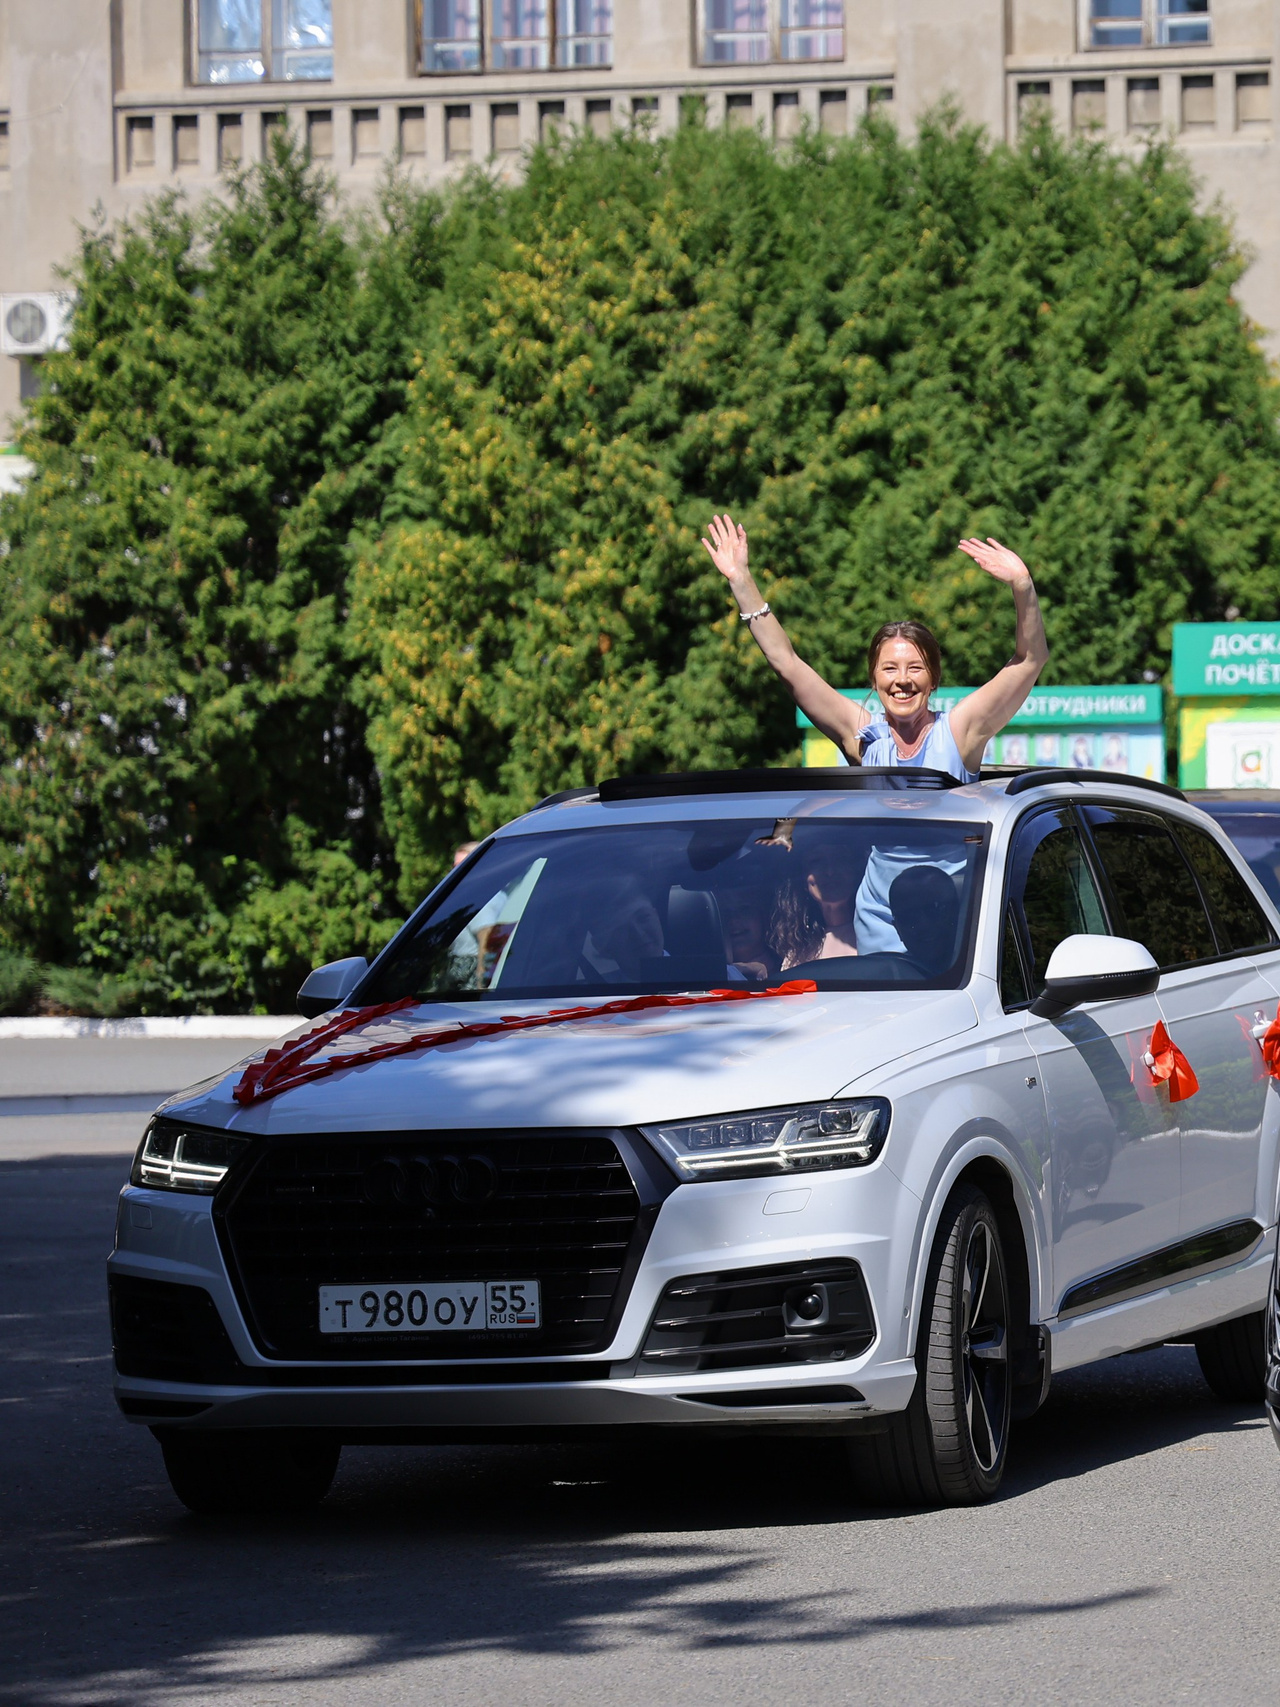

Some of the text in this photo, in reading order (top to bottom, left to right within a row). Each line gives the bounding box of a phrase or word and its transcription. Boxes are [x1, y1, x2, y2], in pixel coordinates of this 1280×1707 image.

[1014, 695, 1147, 717] ОТРУДНИКИ
[490, 1285, 527, 1313] 55
[490, 1313, 516, 1324] RUS
